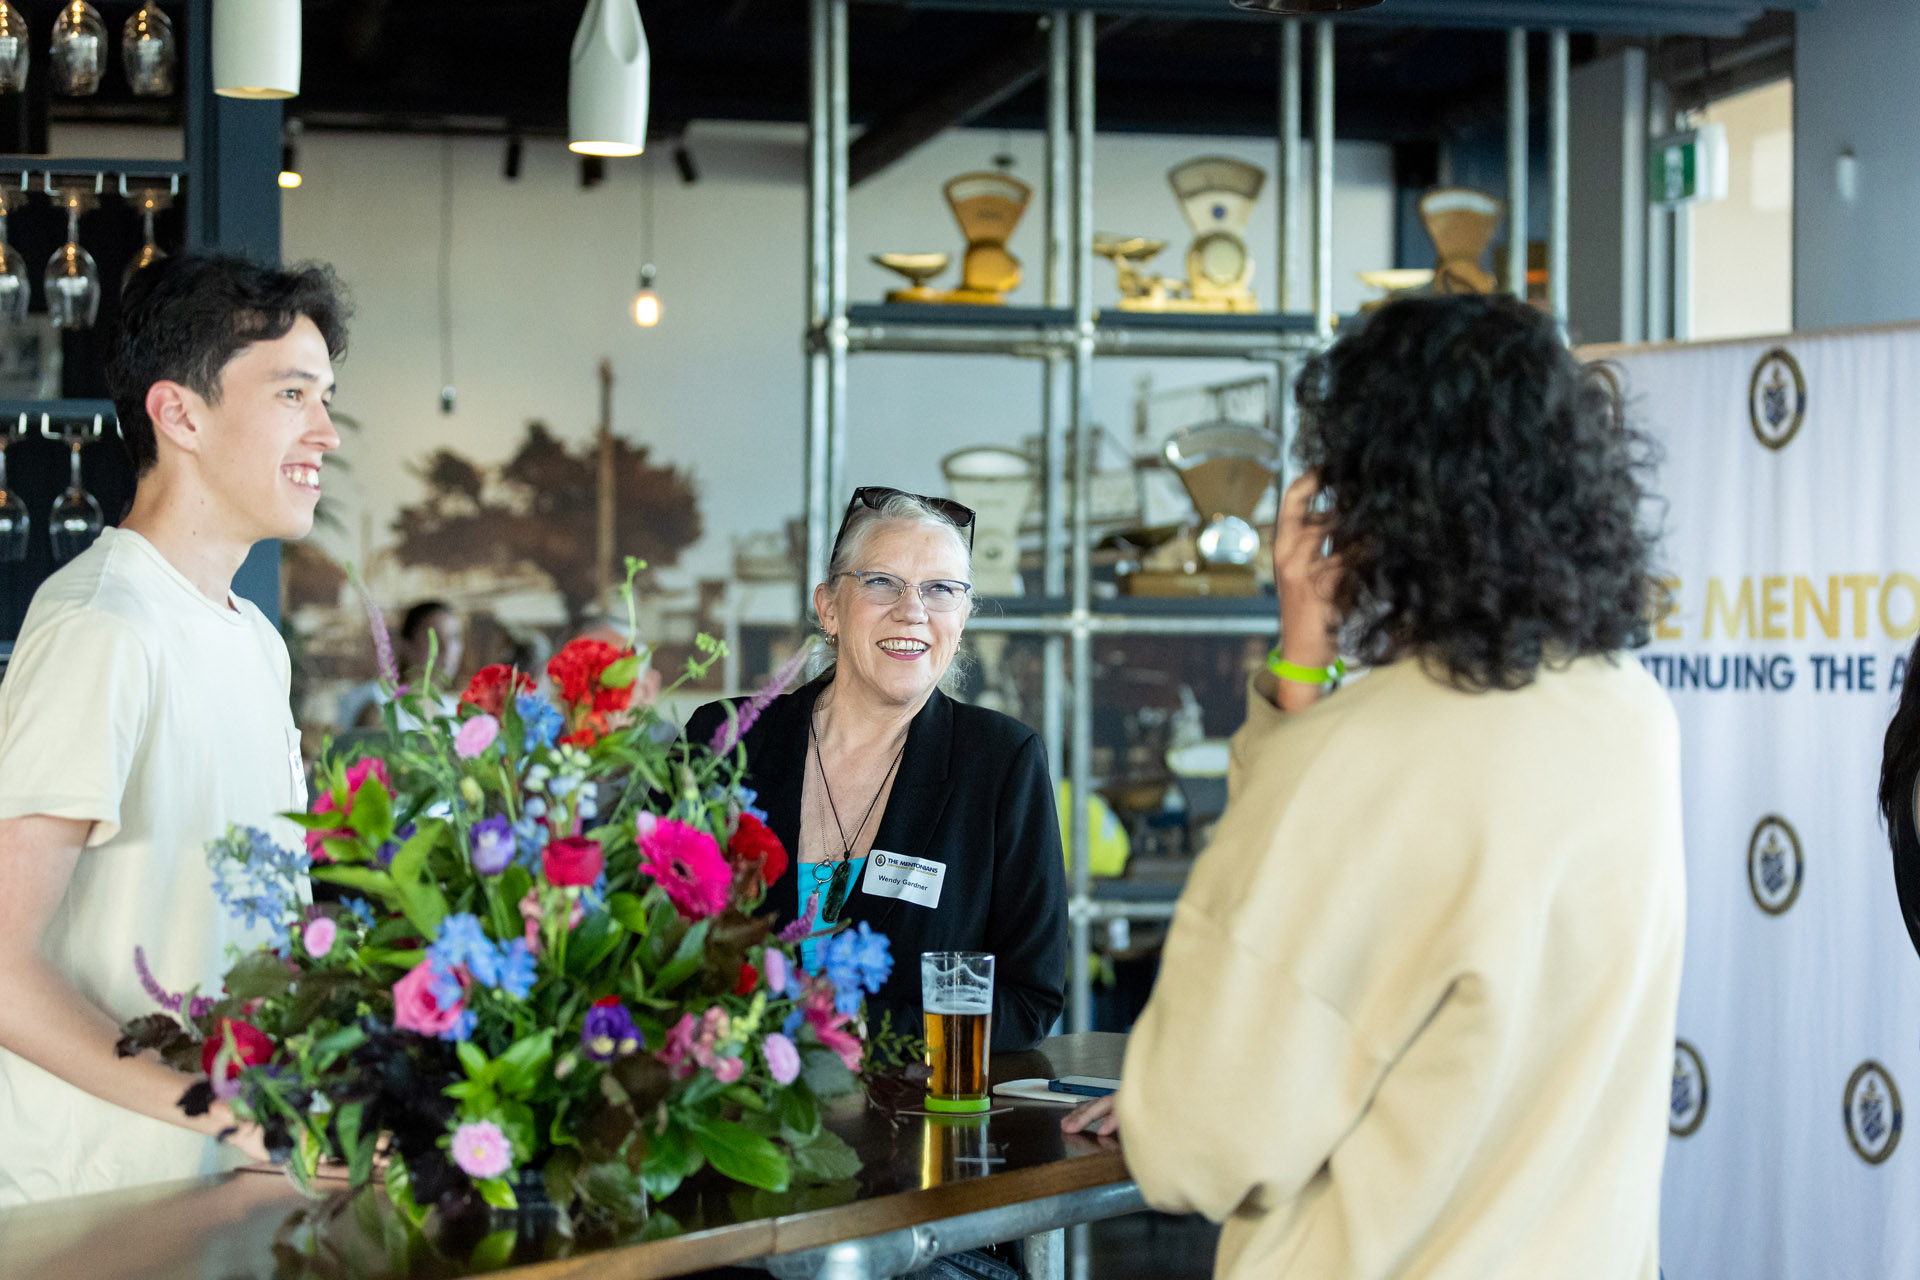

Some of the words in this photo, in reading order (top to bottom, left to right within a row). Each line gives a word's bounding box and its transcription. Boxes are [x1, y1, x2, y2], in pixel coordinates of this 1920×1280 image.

[1702, 572, 1920, 641] MENTO
[1640, 653, 1796, 692] TINUING
[1808, 654, 1876, 692] THE
[888, 857, 899, 865] THE
[900, 860, 938, 874] MENTONIANS
[878, 874, 901, 886] Wendy
[902, 878, 928, 891] Gardner
